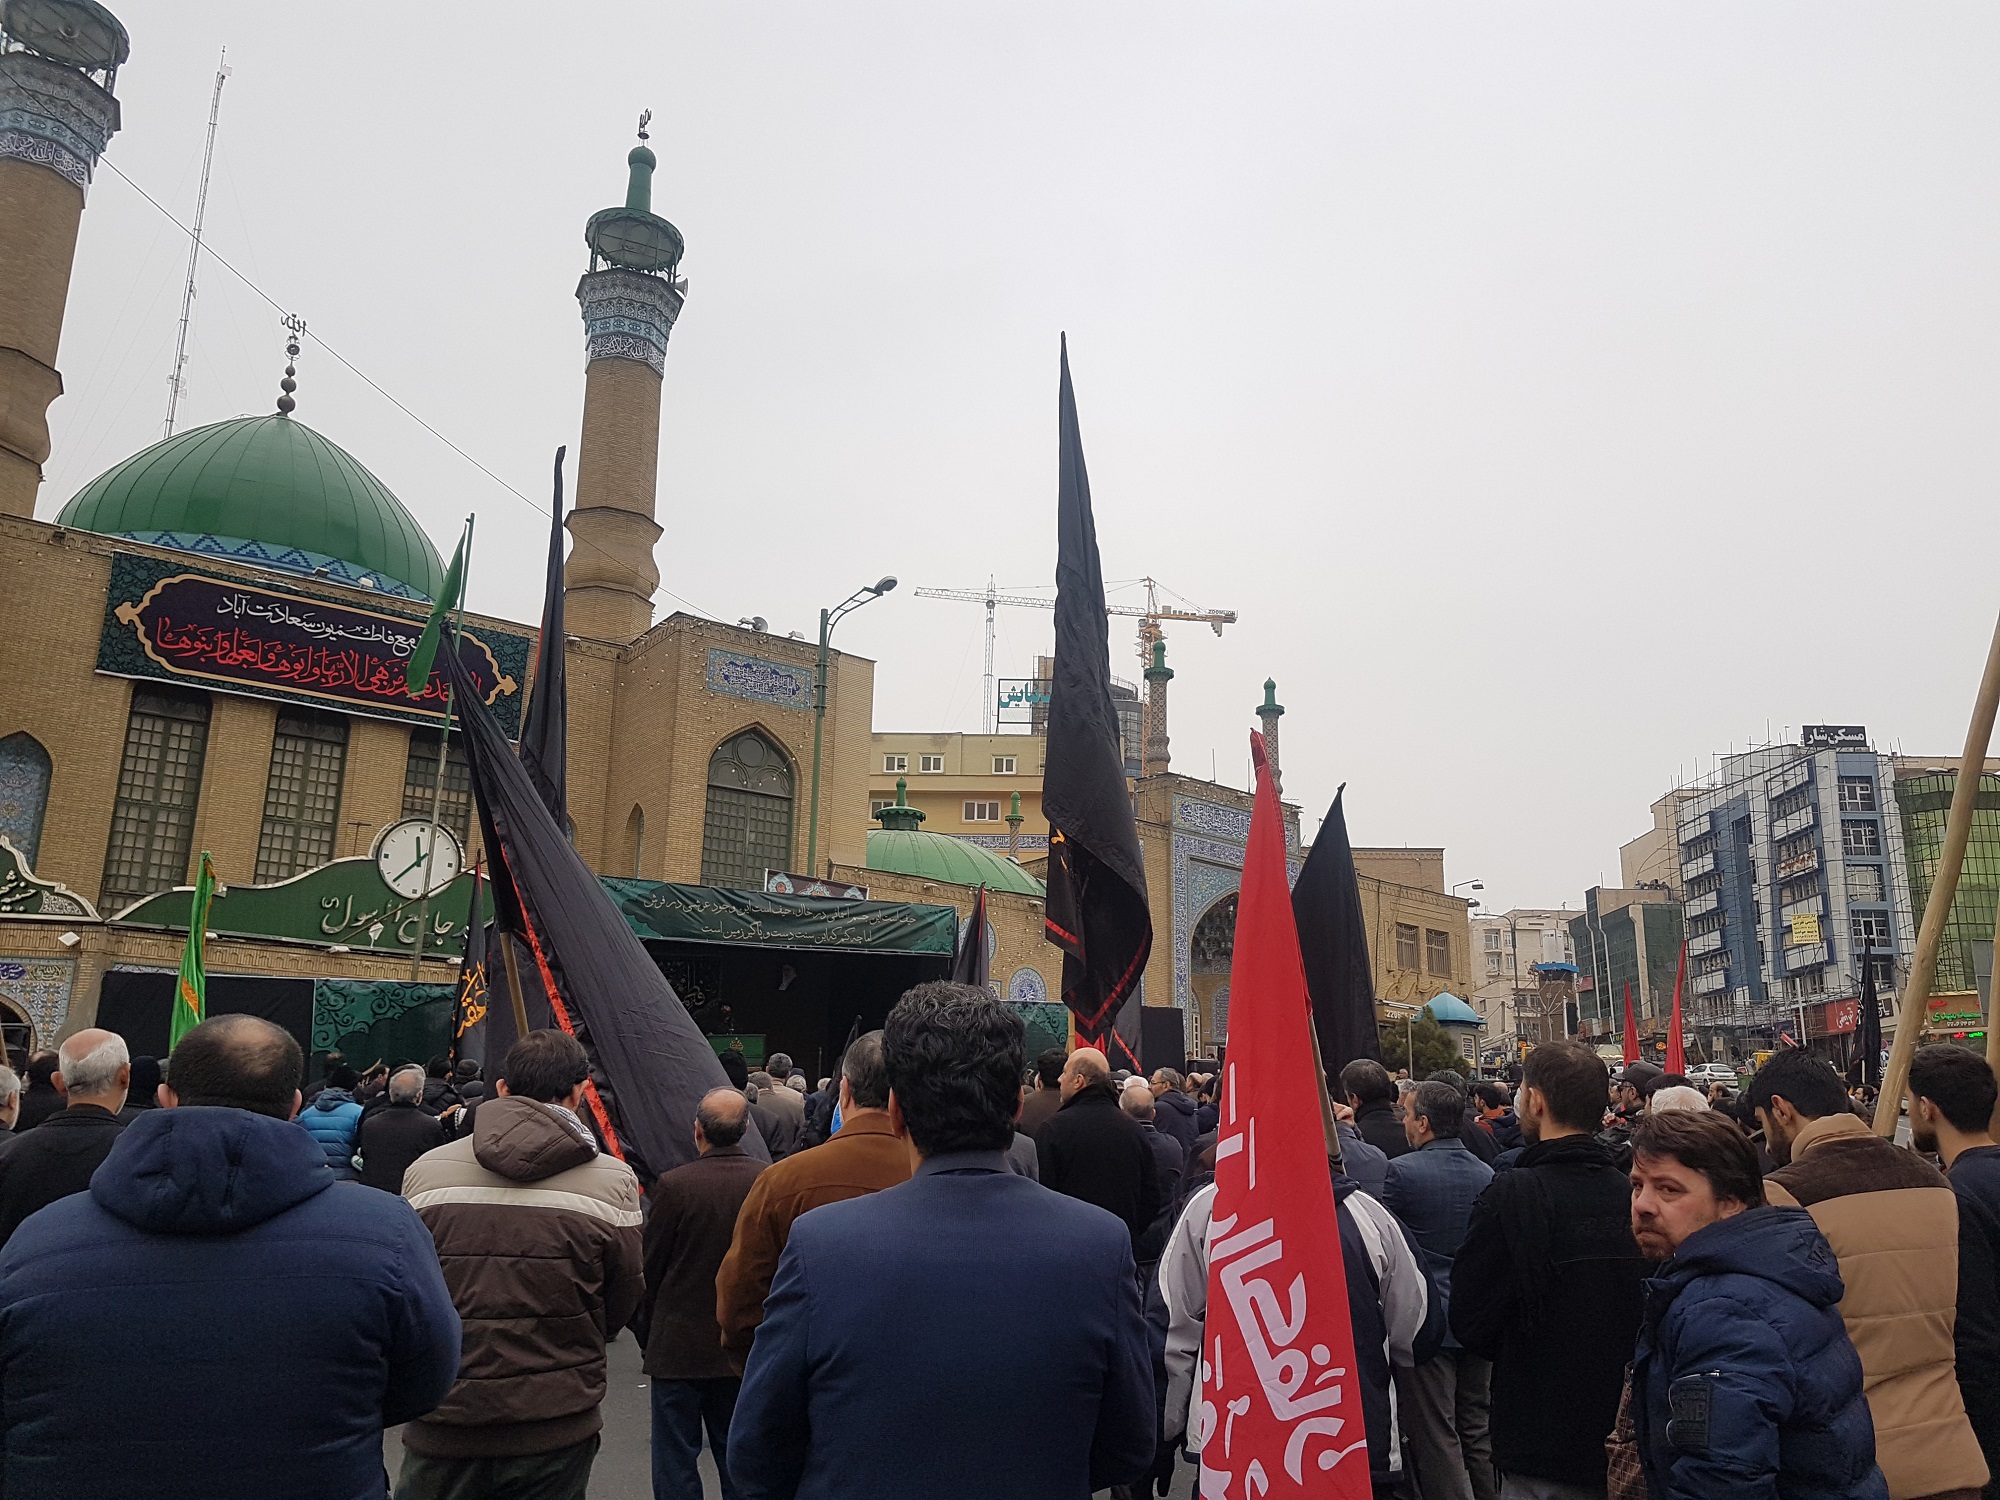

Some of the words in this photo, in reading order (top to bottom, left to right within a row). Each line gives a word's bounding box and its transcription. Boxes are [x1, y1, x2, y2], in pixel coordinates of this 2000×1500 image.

[216, 593, 251, 619] آباد
[247, 604, 316, 629] سعادت
[1806, 727, 1827, 744] شار
[1827, 728, 1864, 745] مسکن
[666, 900, 682, 909] در
[711, 902, 736, 914] وجود
[736, 899, 752, 916] این
[752, 901, 772, 912] است
[813, 911, 827, 919] در
[881, 911, 899, 922] است
[398, 911, 455, 945] جاع
[701, 921, 723, 934] است
[723, 928, 744, 939] زمین
[795, 931, 815, 940] سنت
